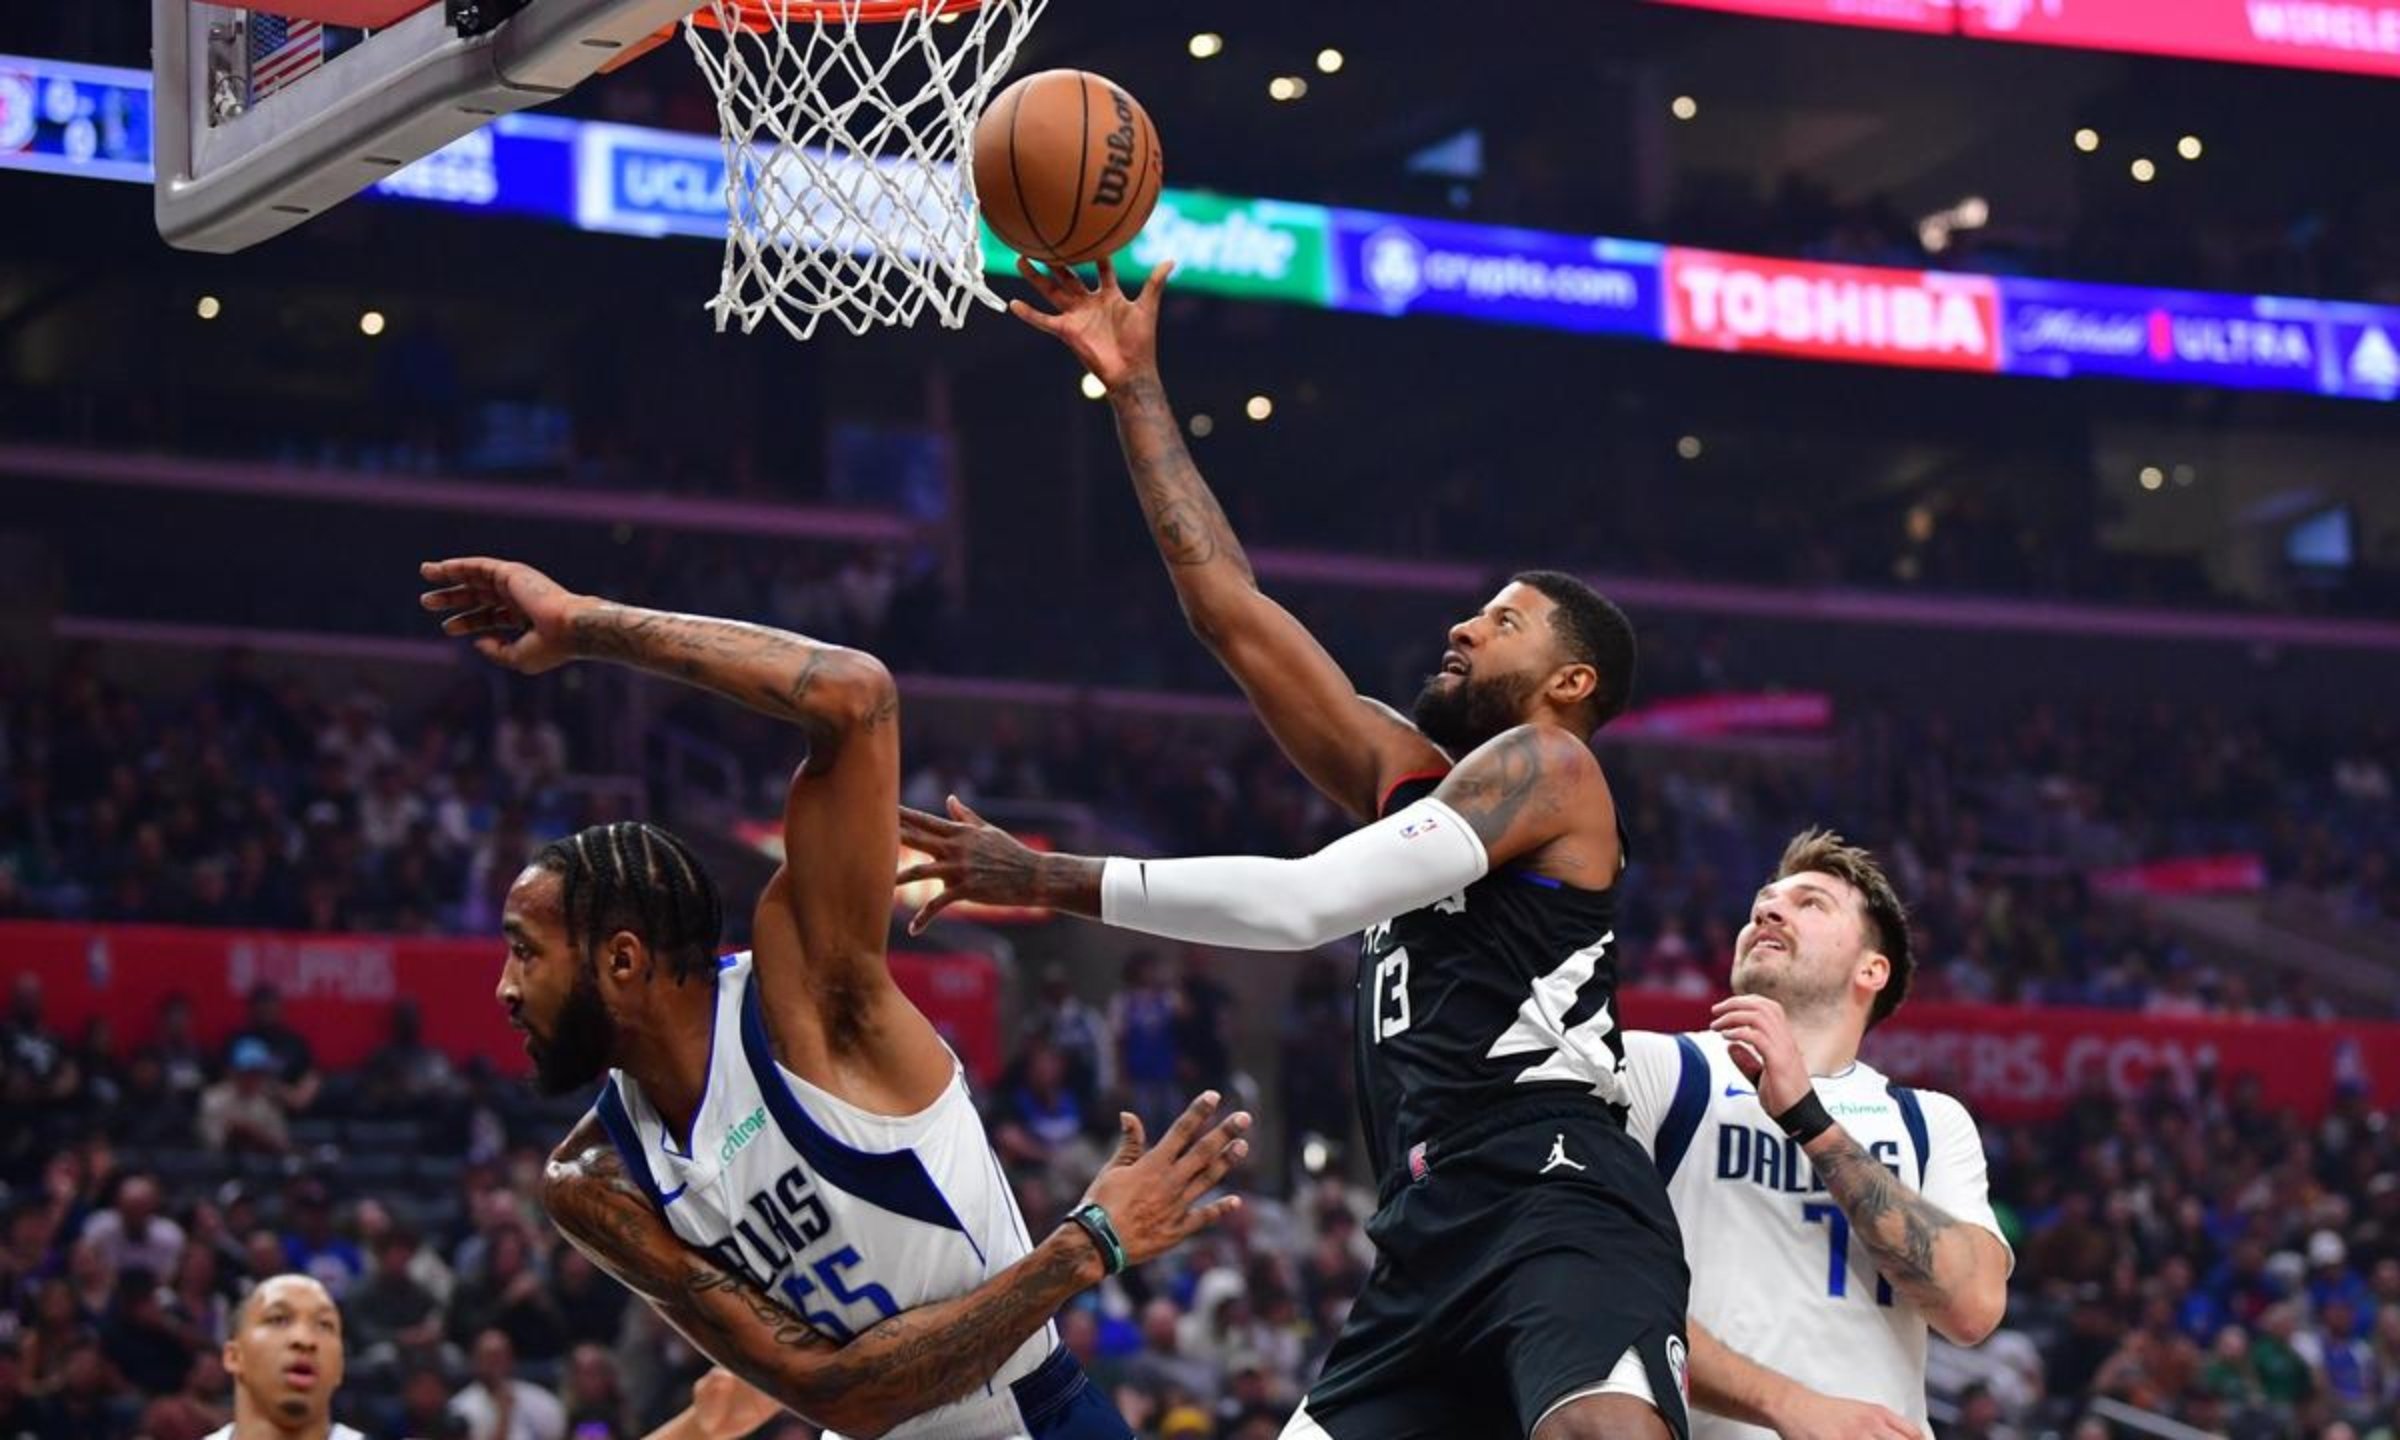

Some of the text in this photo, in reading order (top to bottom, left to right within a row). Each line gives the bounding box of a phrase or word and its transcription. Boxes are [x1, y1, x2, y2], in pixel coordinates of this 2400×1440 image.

[1092, 89, 1135, 206] Wilson
[1130, 205, 1297, 280] Sprite
[1424, 250, 1638, 309] crypto.com
[1678, 266, 1986, 354] TOSHIBA
[2173, 316, 2312, 368] ULTRA
[1373, 946, 1411, 1044] 13
[721, 1106, 768, 1163] chime
[1716, 1123, 1900, 1194] DALS
